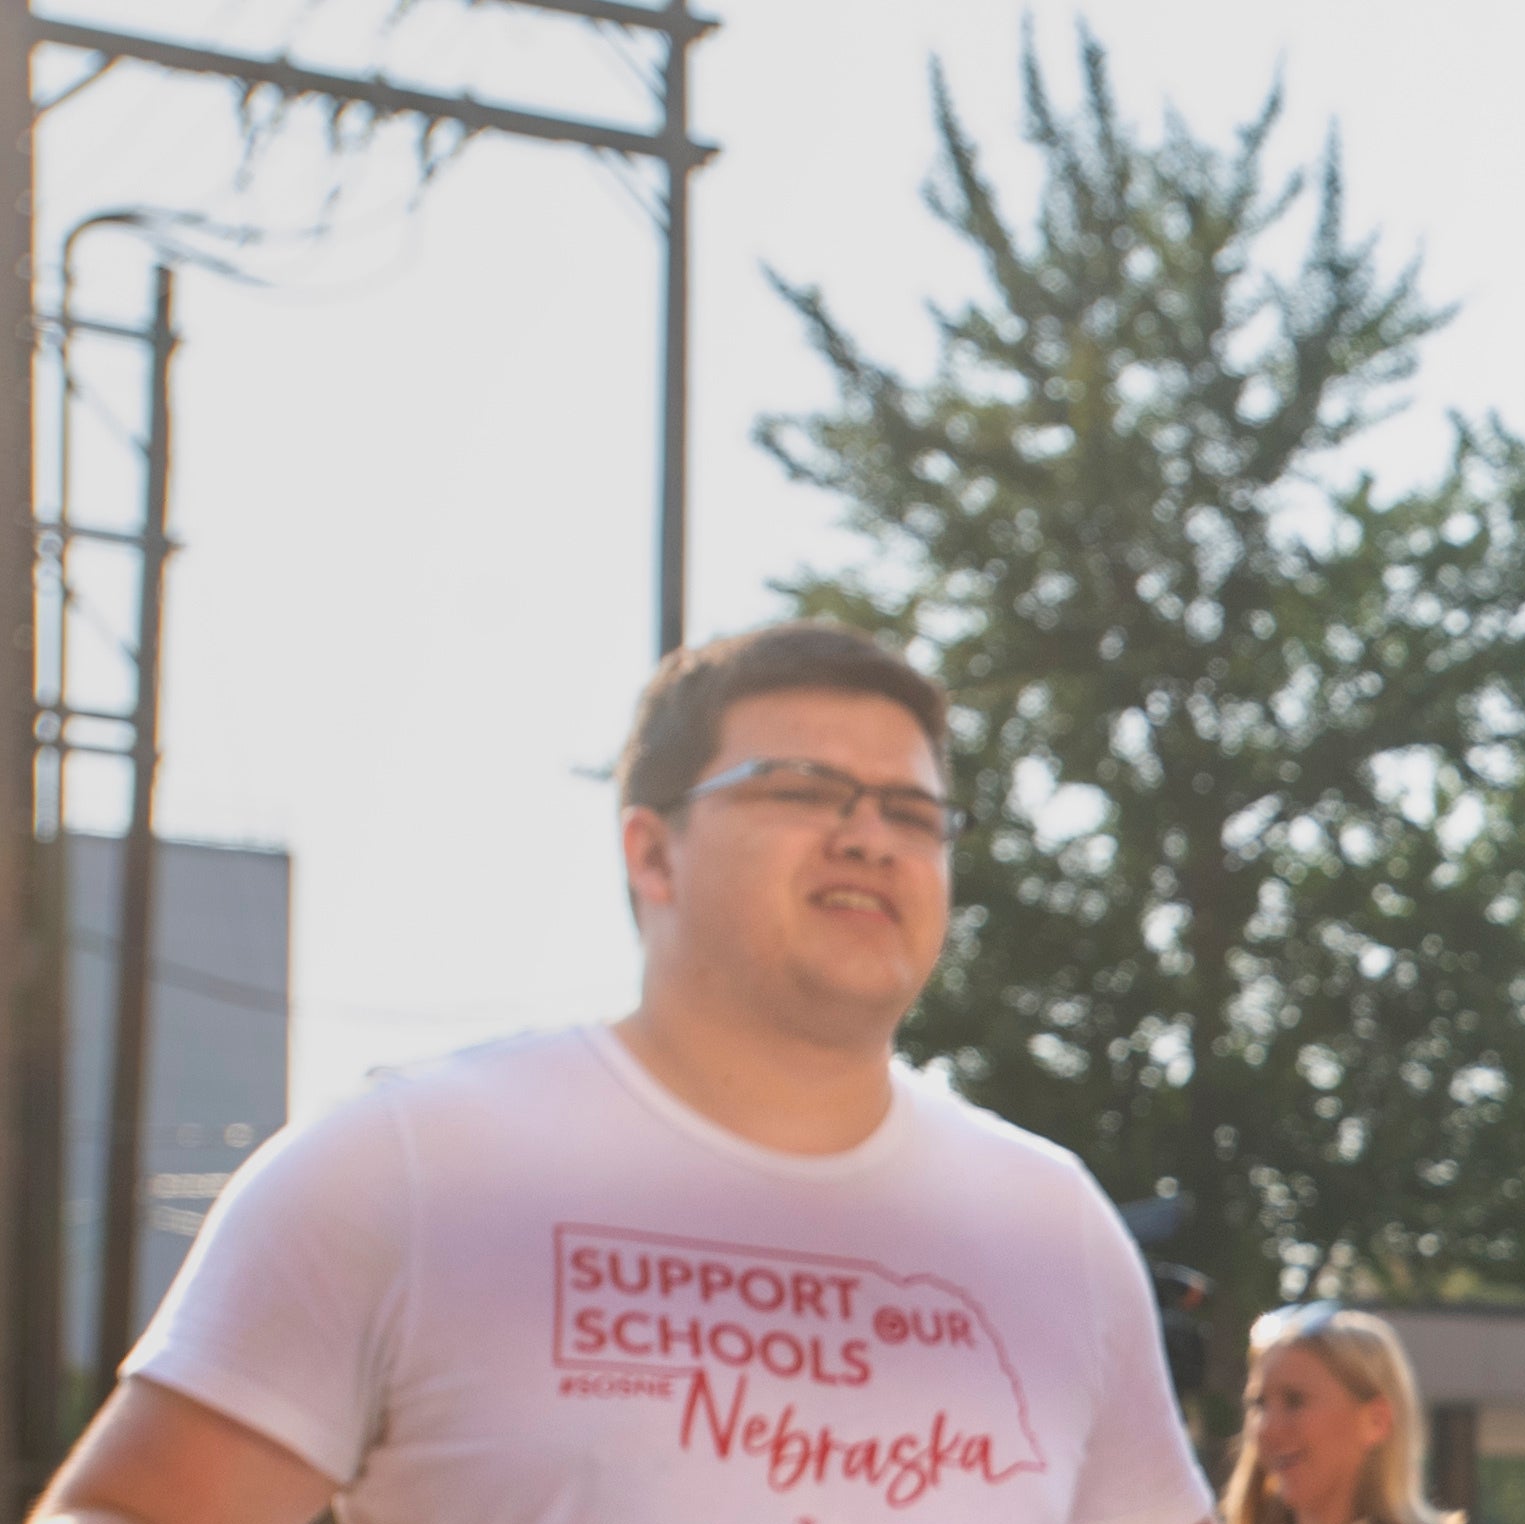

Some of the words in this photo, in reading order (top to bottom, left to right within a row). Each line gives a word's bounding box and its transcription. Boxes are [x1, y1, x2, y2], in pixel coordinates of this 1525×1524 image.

[570, 1246, 862, 1323] SUPPORT
[873, 1305, 977, 1350] OUR
[572, 1307, 873, 1387] SCHOOLS
[680, 1367, 1012, 1510] Nebraska
